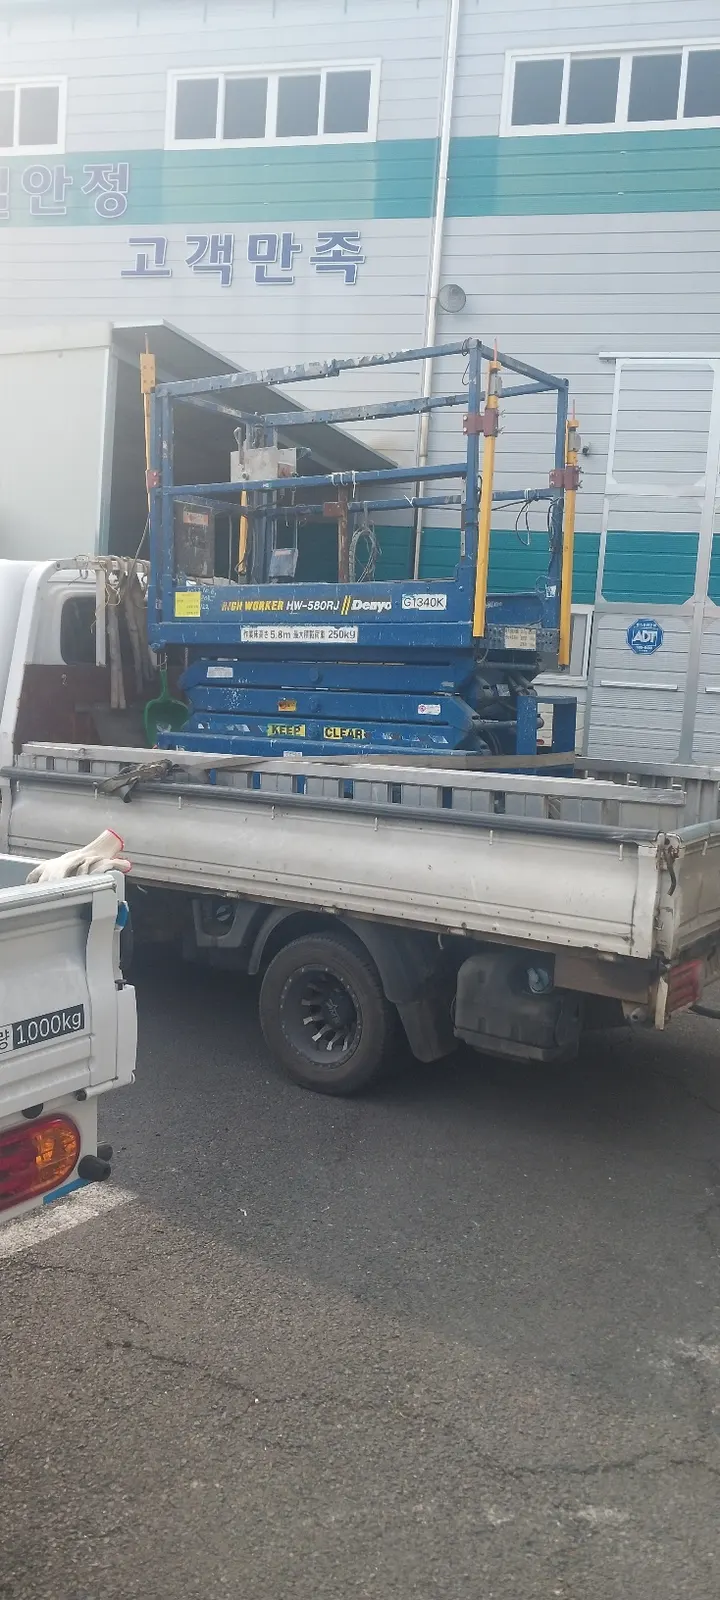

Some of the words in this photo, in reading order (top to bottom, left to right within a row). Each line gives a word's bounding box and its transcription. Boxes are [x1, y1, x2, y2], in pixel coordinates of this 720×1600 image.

[120, 230, 366, 287] 고객만족
[221, 600, 243, 612] HIGH
[244, 600, 284, 611] WORKER
[286, 600, 340, 612] HW-580RJ
[350, 599, 392, 613] Denyo
[403, 596, 444, 608] G1340K
[270, 629, 291, 639] 5.8m
[328, 629, 356, 639] 250kg
[633, 629, 657, 643] ADT
[271, 724, 301, 735] KEEP
[324, 727, 364, 740] CLEAR
